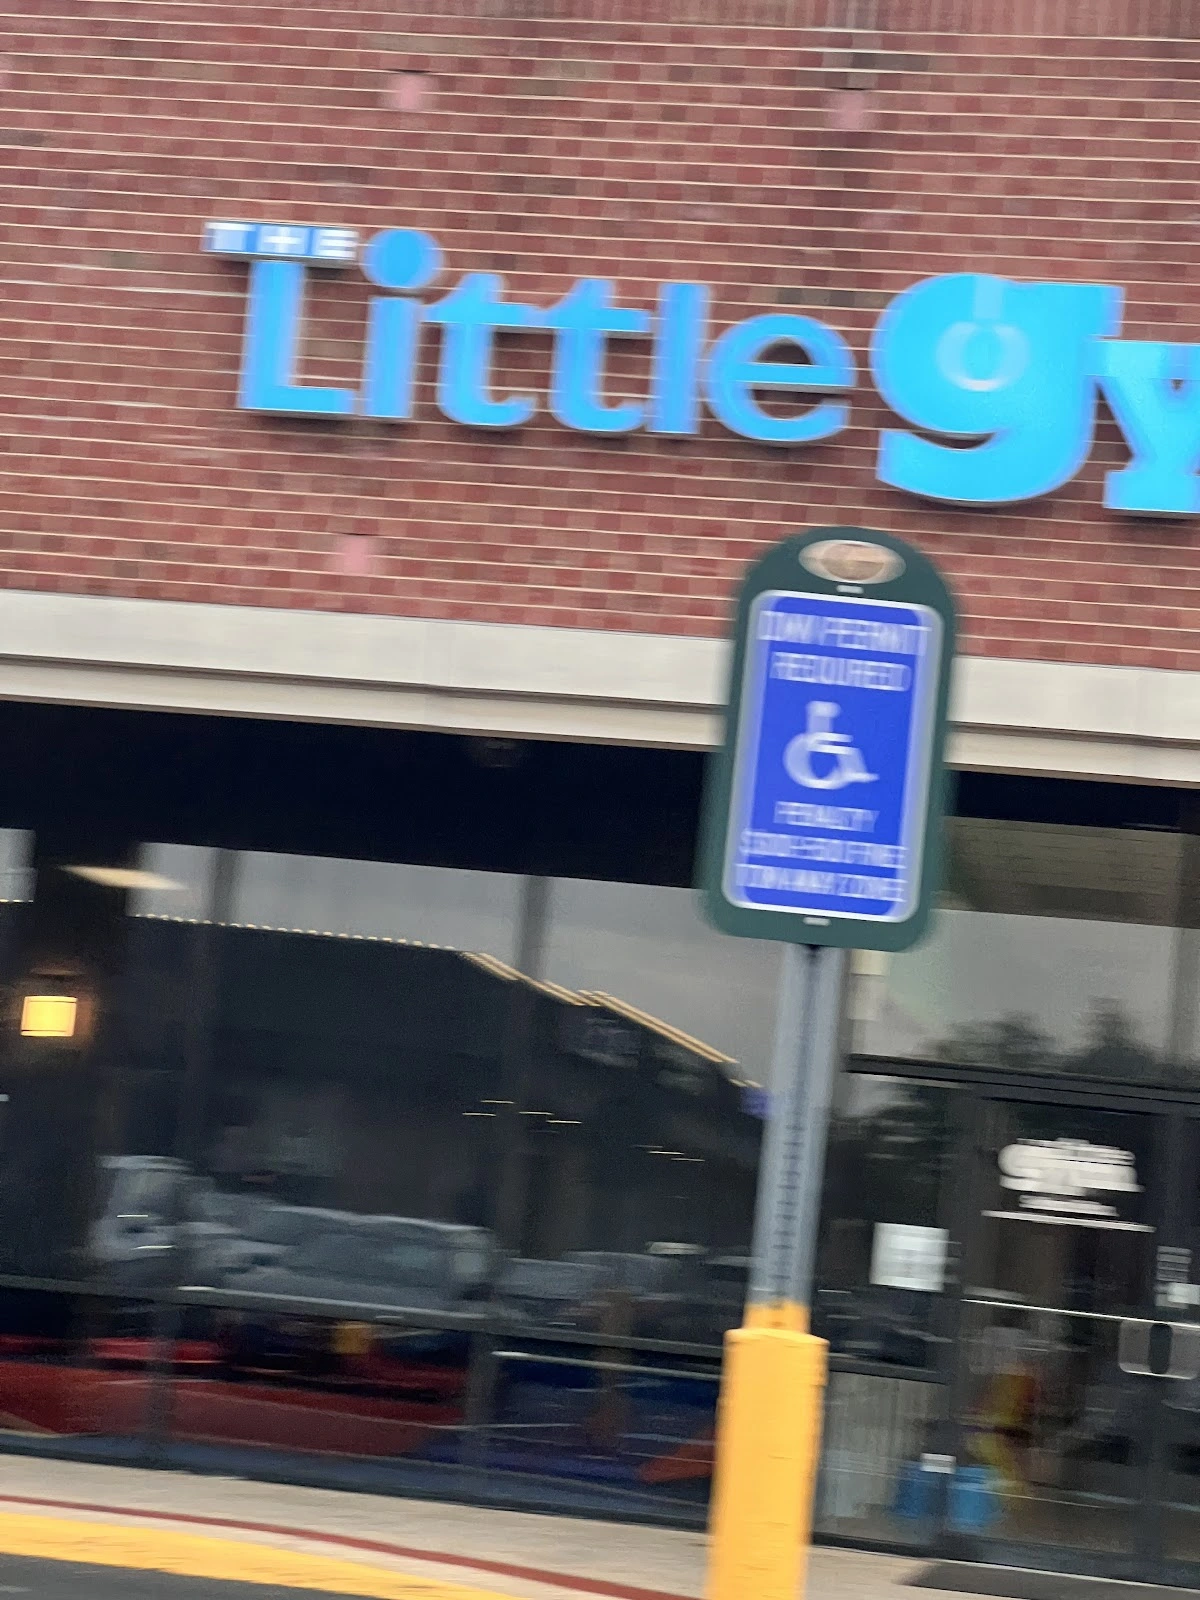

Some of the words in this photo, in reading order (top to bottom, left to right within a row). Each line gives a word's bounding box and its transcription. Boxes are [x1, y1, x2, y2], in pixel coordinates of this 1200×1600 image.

[203, 221, 359, 262] THE
[237, 228, 856, 441] Little
[770, 651, 911, 692] REQUIRED
[774, 801, 878, 833] PENALTY
